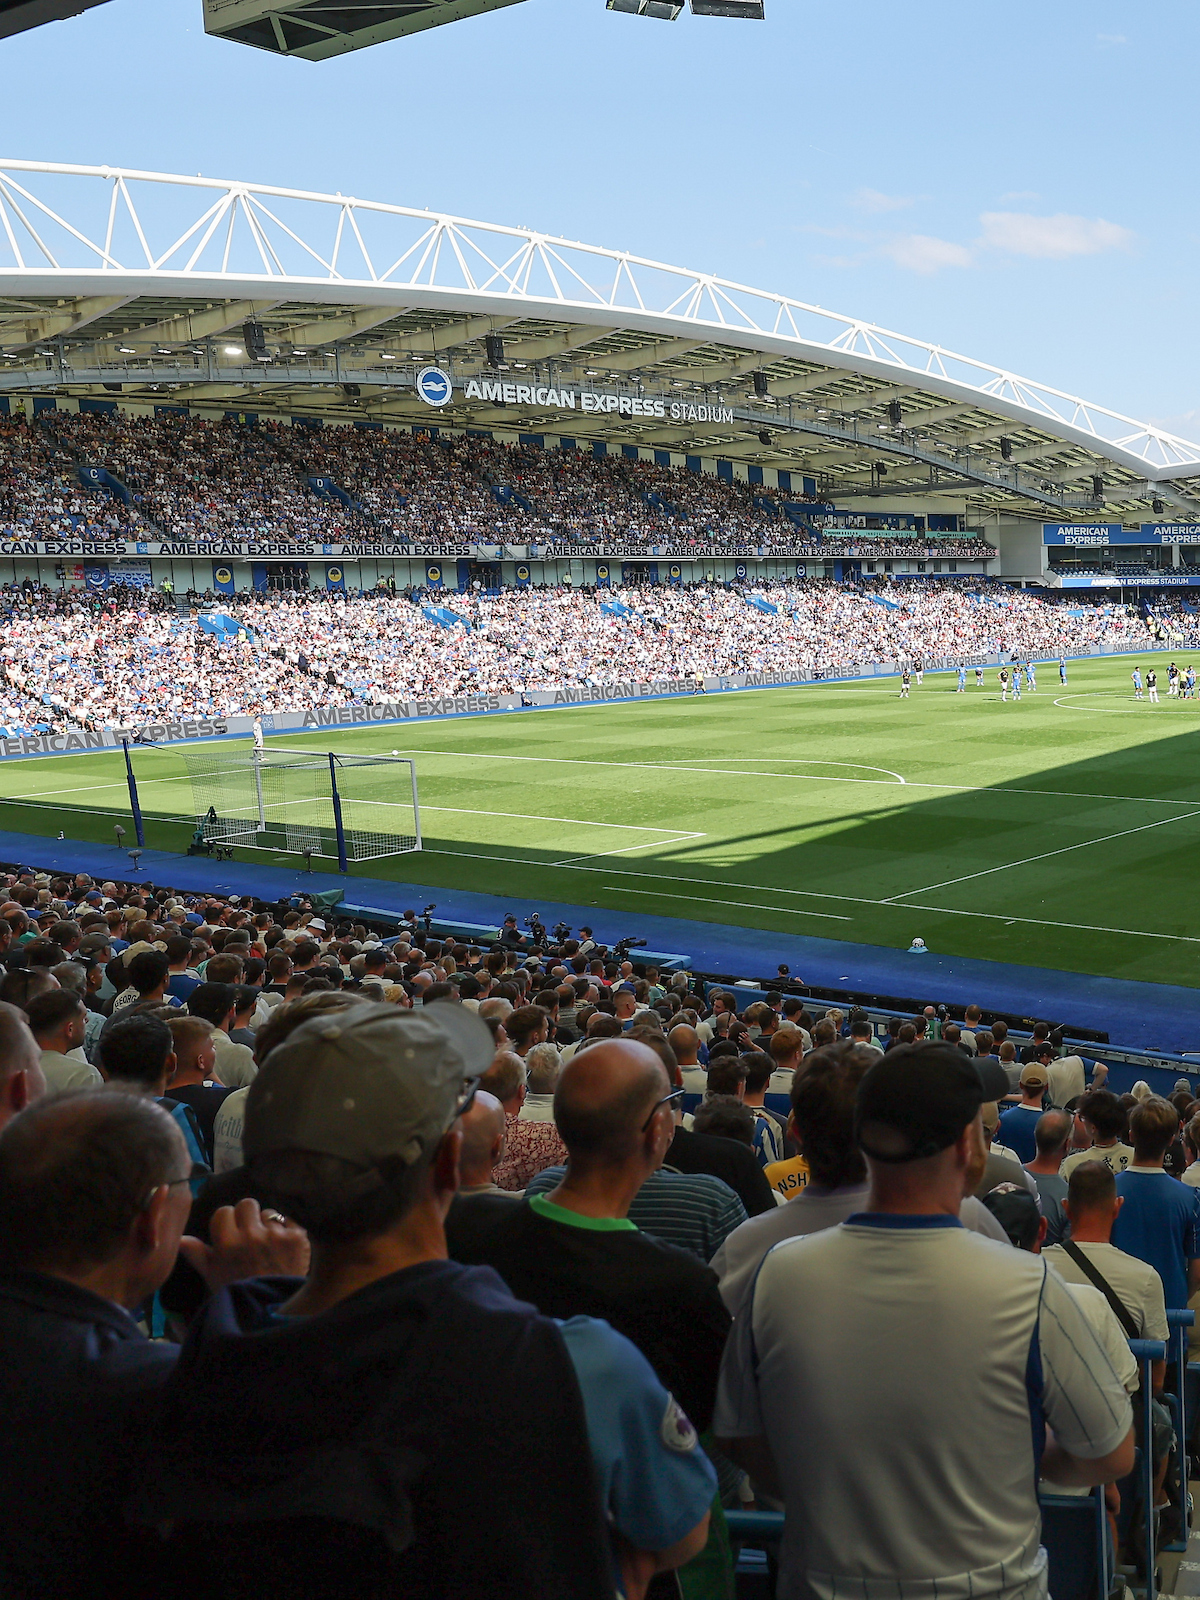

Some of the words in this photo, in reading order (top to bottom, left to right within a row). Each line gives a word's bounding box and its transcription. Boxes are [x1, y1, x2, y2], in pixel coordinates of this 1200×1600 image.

[465, 380, 576, 409] AMERICAN
[581, 392, 665, 417] EXPRESS
[671, 402, 734, 424] STADIUM
[90, 469, 98, 479] C
[316, 479, 324, 488] D
[1057, 527, 1109, 536] AMERICAN
[1064, 536, 1110, 545] EXPRESS
[0, 542, 38, 555] CAN
[45, 542, 127, 555] EXPRESS
[159, 543, 242, 555] AMERICAN
[249, 544, 315, 555] EXPRESS
[341, 544, 410, 556] AMERICAN
[415, 545, 470, 556] EXPRESS
[545, 546, 600, 556] AMERICAN
[604, 546, 648, 556] EXPRESS
[665, 547, 712, 556] AMERICAN
[714, 547, 754, 556] EXPRESS
[768, 548, 808, 556] AMERICAN
[811, 548, 845, 556] EXPRESS
[858, 549, 894, 557] AMERICAN
[896, 549, 926, 557] EXPRESS
[1113, 641, 1148, 652] AMERICAN
[1058, 648, 1091, 658] EXPRESS
[894, 656, 944, 672] AMEICAN
[947, 654, 988, 668] EXPRESS
[744, 670, 806, 686] AMERICAN
[554, 682, 635, 704] AMERICAN
[303, 703, 410, 726] AMERICAN
[416, 695, 500, 718] EXPRESS
[0, 733, 104, 756] ERICAN
[114, 718, 229, 746] EXPRESS
[773, 1172, 807, 1195] NSH
